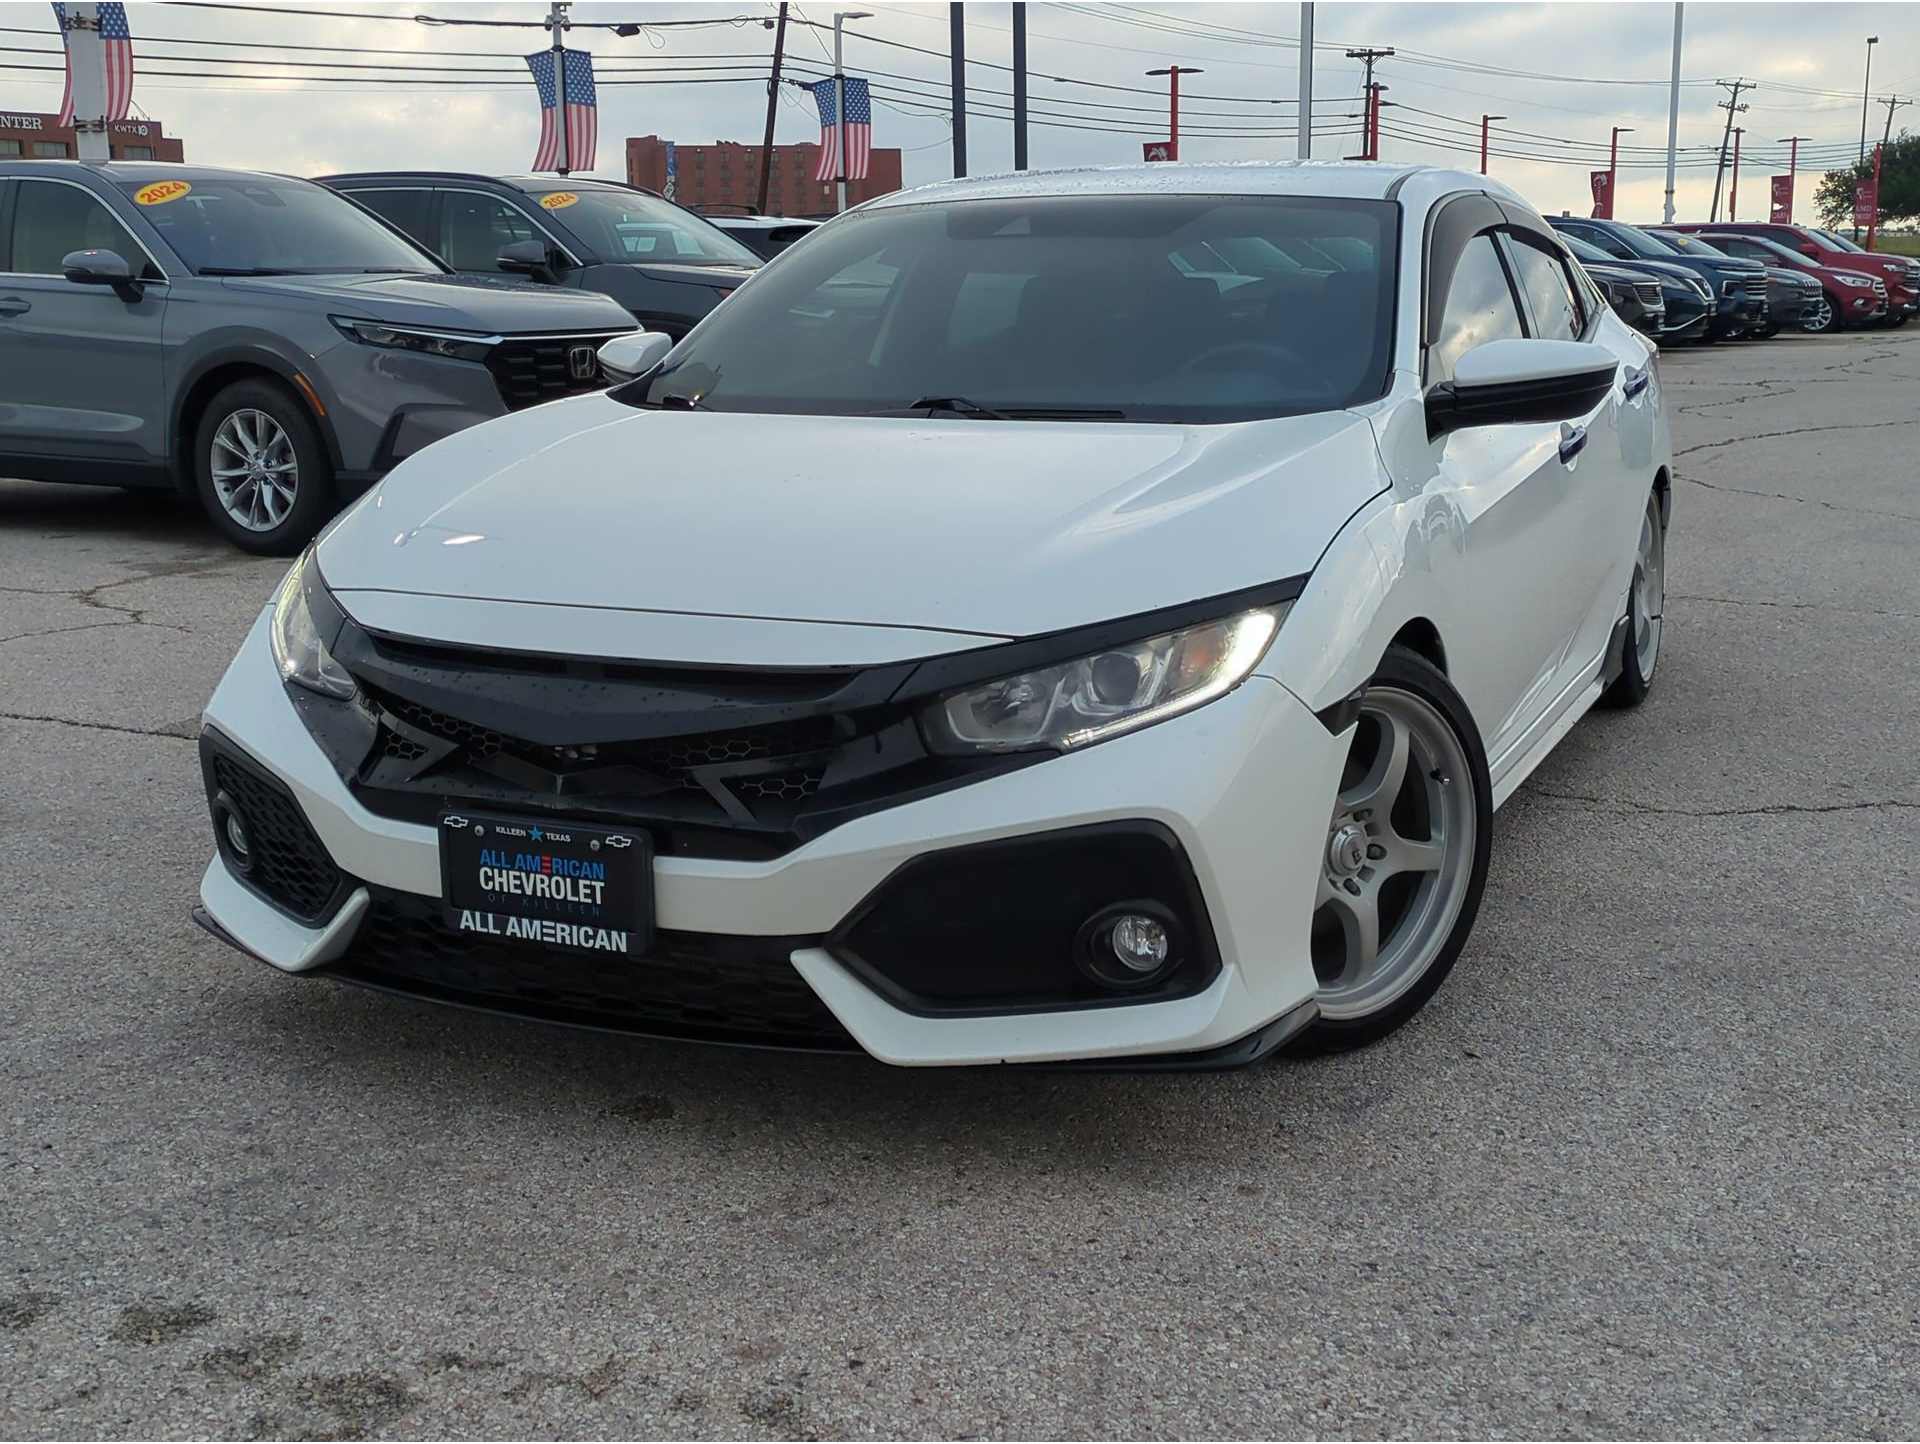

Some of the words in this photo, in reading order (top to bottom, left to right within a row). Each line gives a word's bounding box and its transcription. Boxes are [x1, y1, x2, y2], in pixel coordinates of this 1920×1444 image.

[139, 182, 186, 203] 2024
[495, 825, 527, 838] KILLEEN
[546, 832, 571, 843] TEXAS
[480, 849, 511, 868] ALL
[514, 853, 605, 880] AMERICAN
[479, 866, 605, 905] CHEVROLET
[459, 910, 501, 934] ALL
[505, 916, 627, 953] AMERICAN
